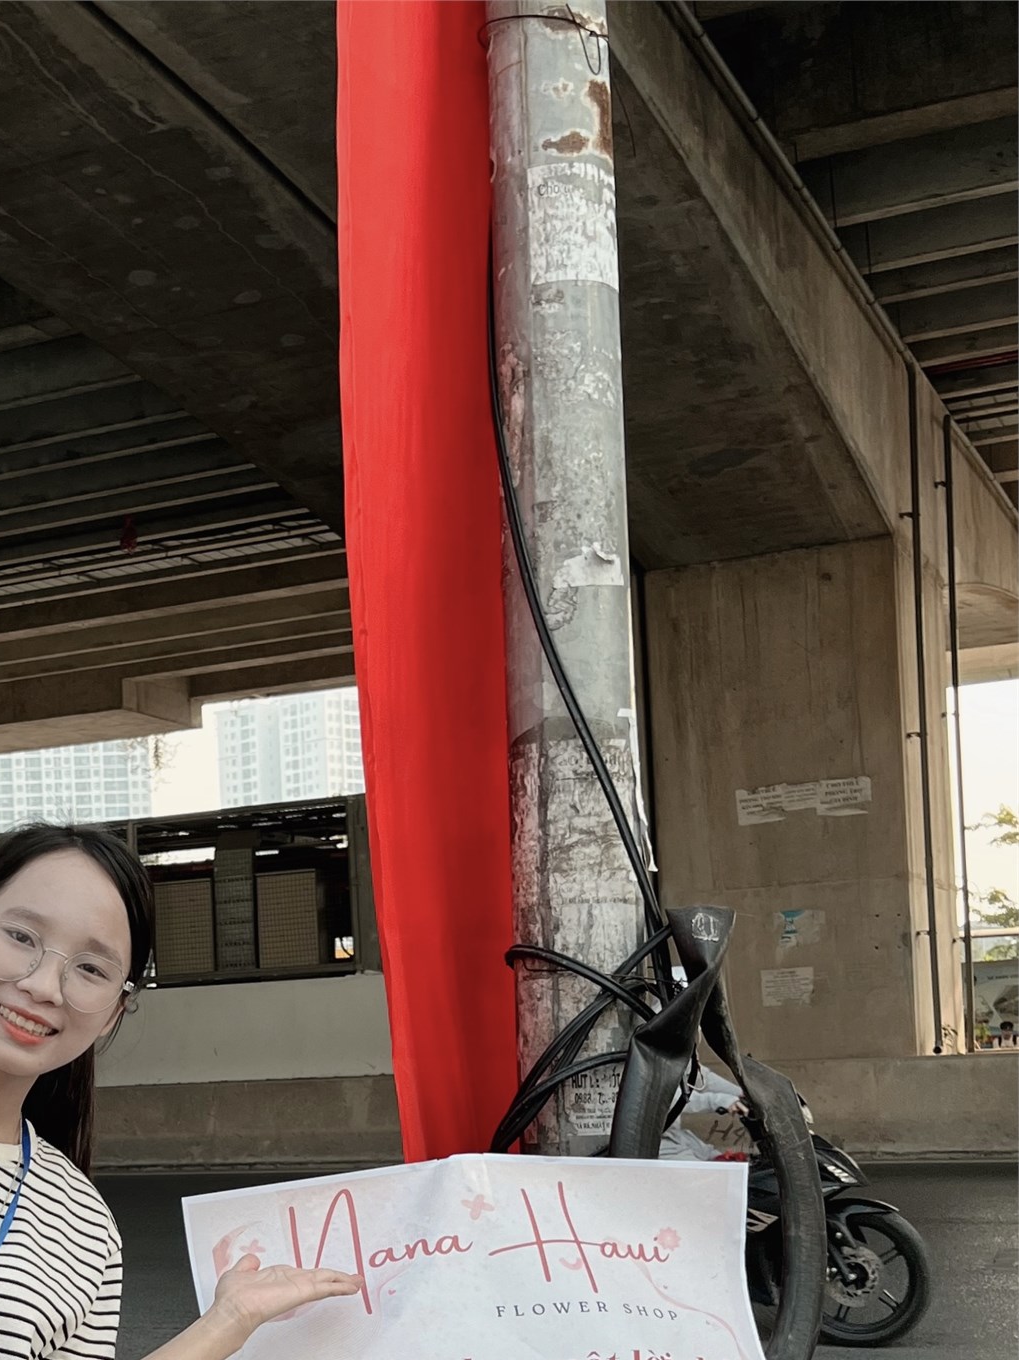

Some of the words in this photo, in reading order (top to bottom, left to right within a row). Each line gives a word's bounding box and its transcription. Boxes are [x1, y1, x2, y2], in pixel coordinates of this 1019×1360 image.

[288, 1188, 474, 1315] Nana
[488, 1180, 670, 1294] Haui
[495, 1300, 609, 1318] FLOWER
[622, 1302, 678, 1321] SHOP
